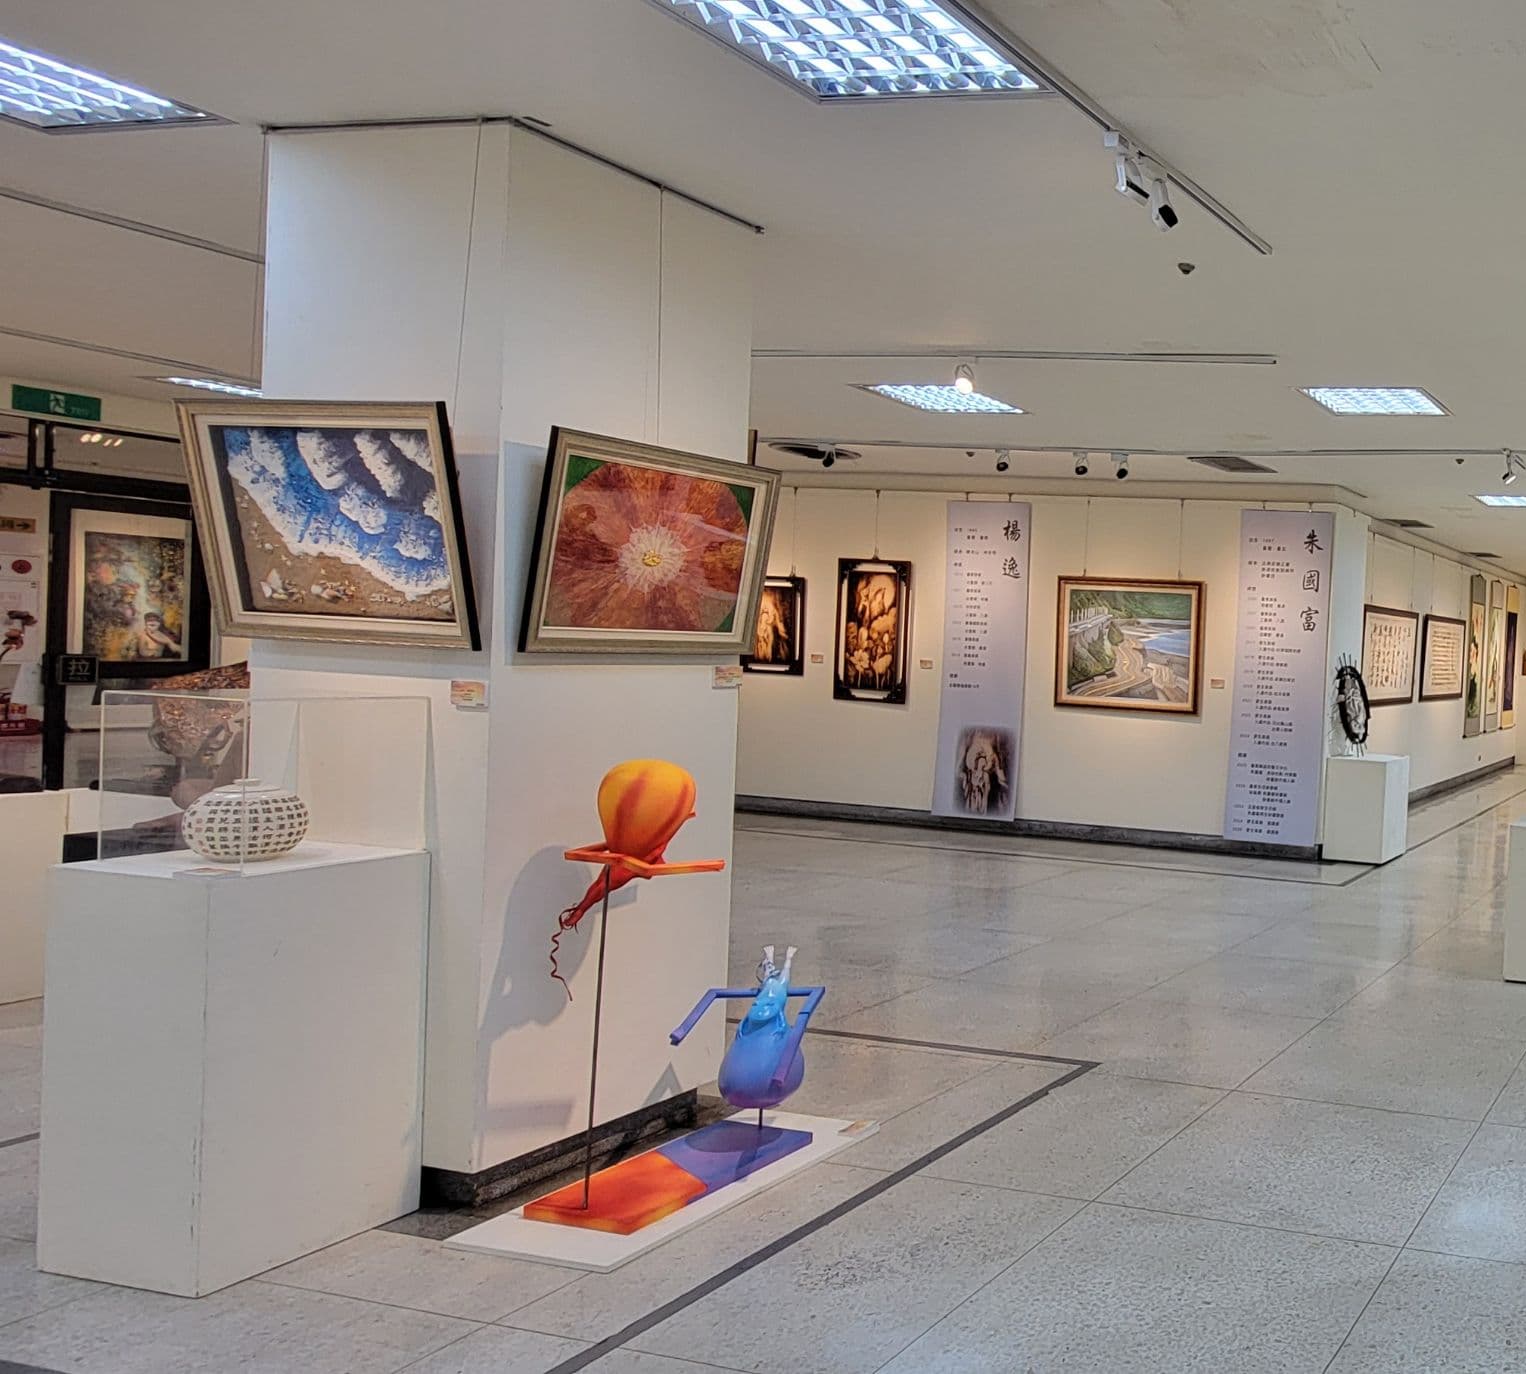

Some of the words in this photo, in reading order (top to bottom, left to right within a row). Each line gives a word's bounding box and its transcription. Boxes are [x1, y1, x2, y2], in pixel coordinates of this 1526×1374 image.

[1001, 520, 1022, 580] 楊逸
[1299, 528, 1325, 633] 朱國富
